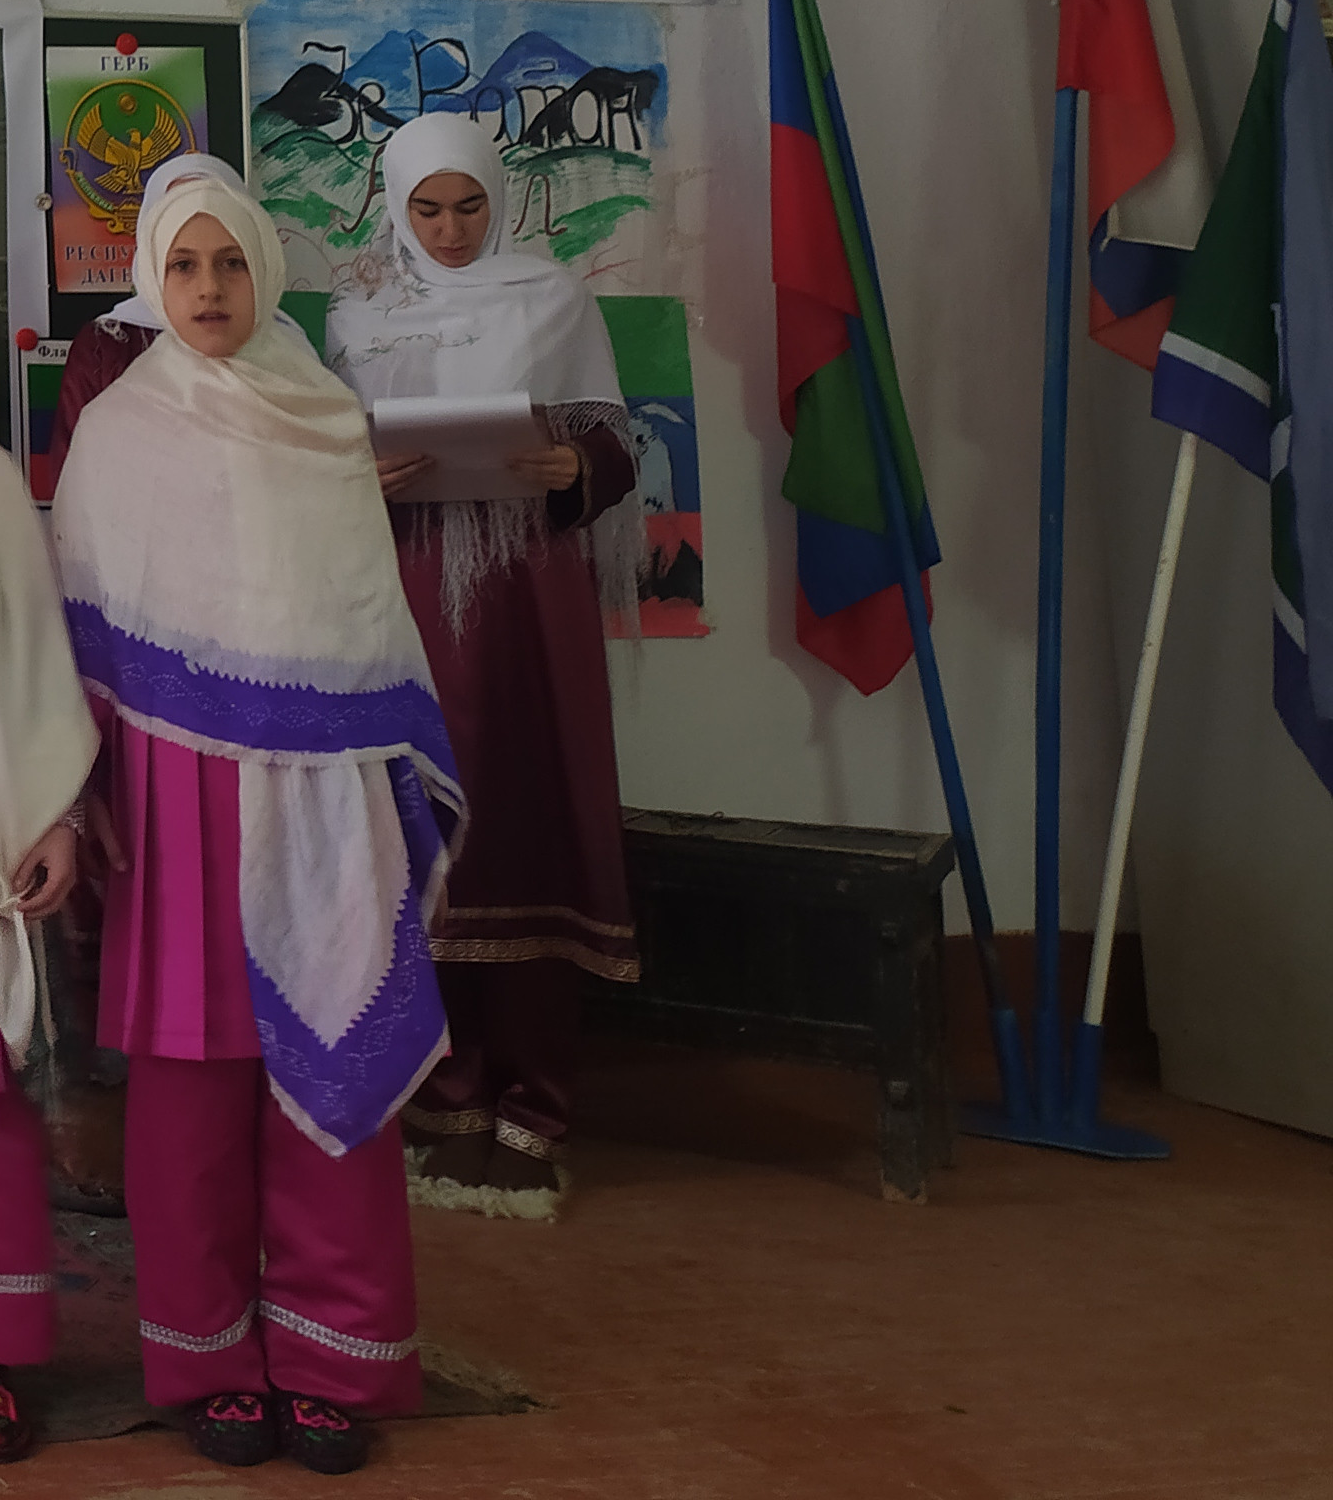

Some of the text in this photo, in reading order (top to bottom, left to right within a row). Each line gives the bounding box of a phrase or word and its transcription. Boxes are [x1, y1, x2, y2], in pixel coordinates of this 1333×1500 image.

[101, 56, 149, 72] ГЕРБ
[65, 245, 137, 262] РЕСПУ
[81, 267, 133, 285] ДАГЕ
[38, 345, 67, 358] Фла
